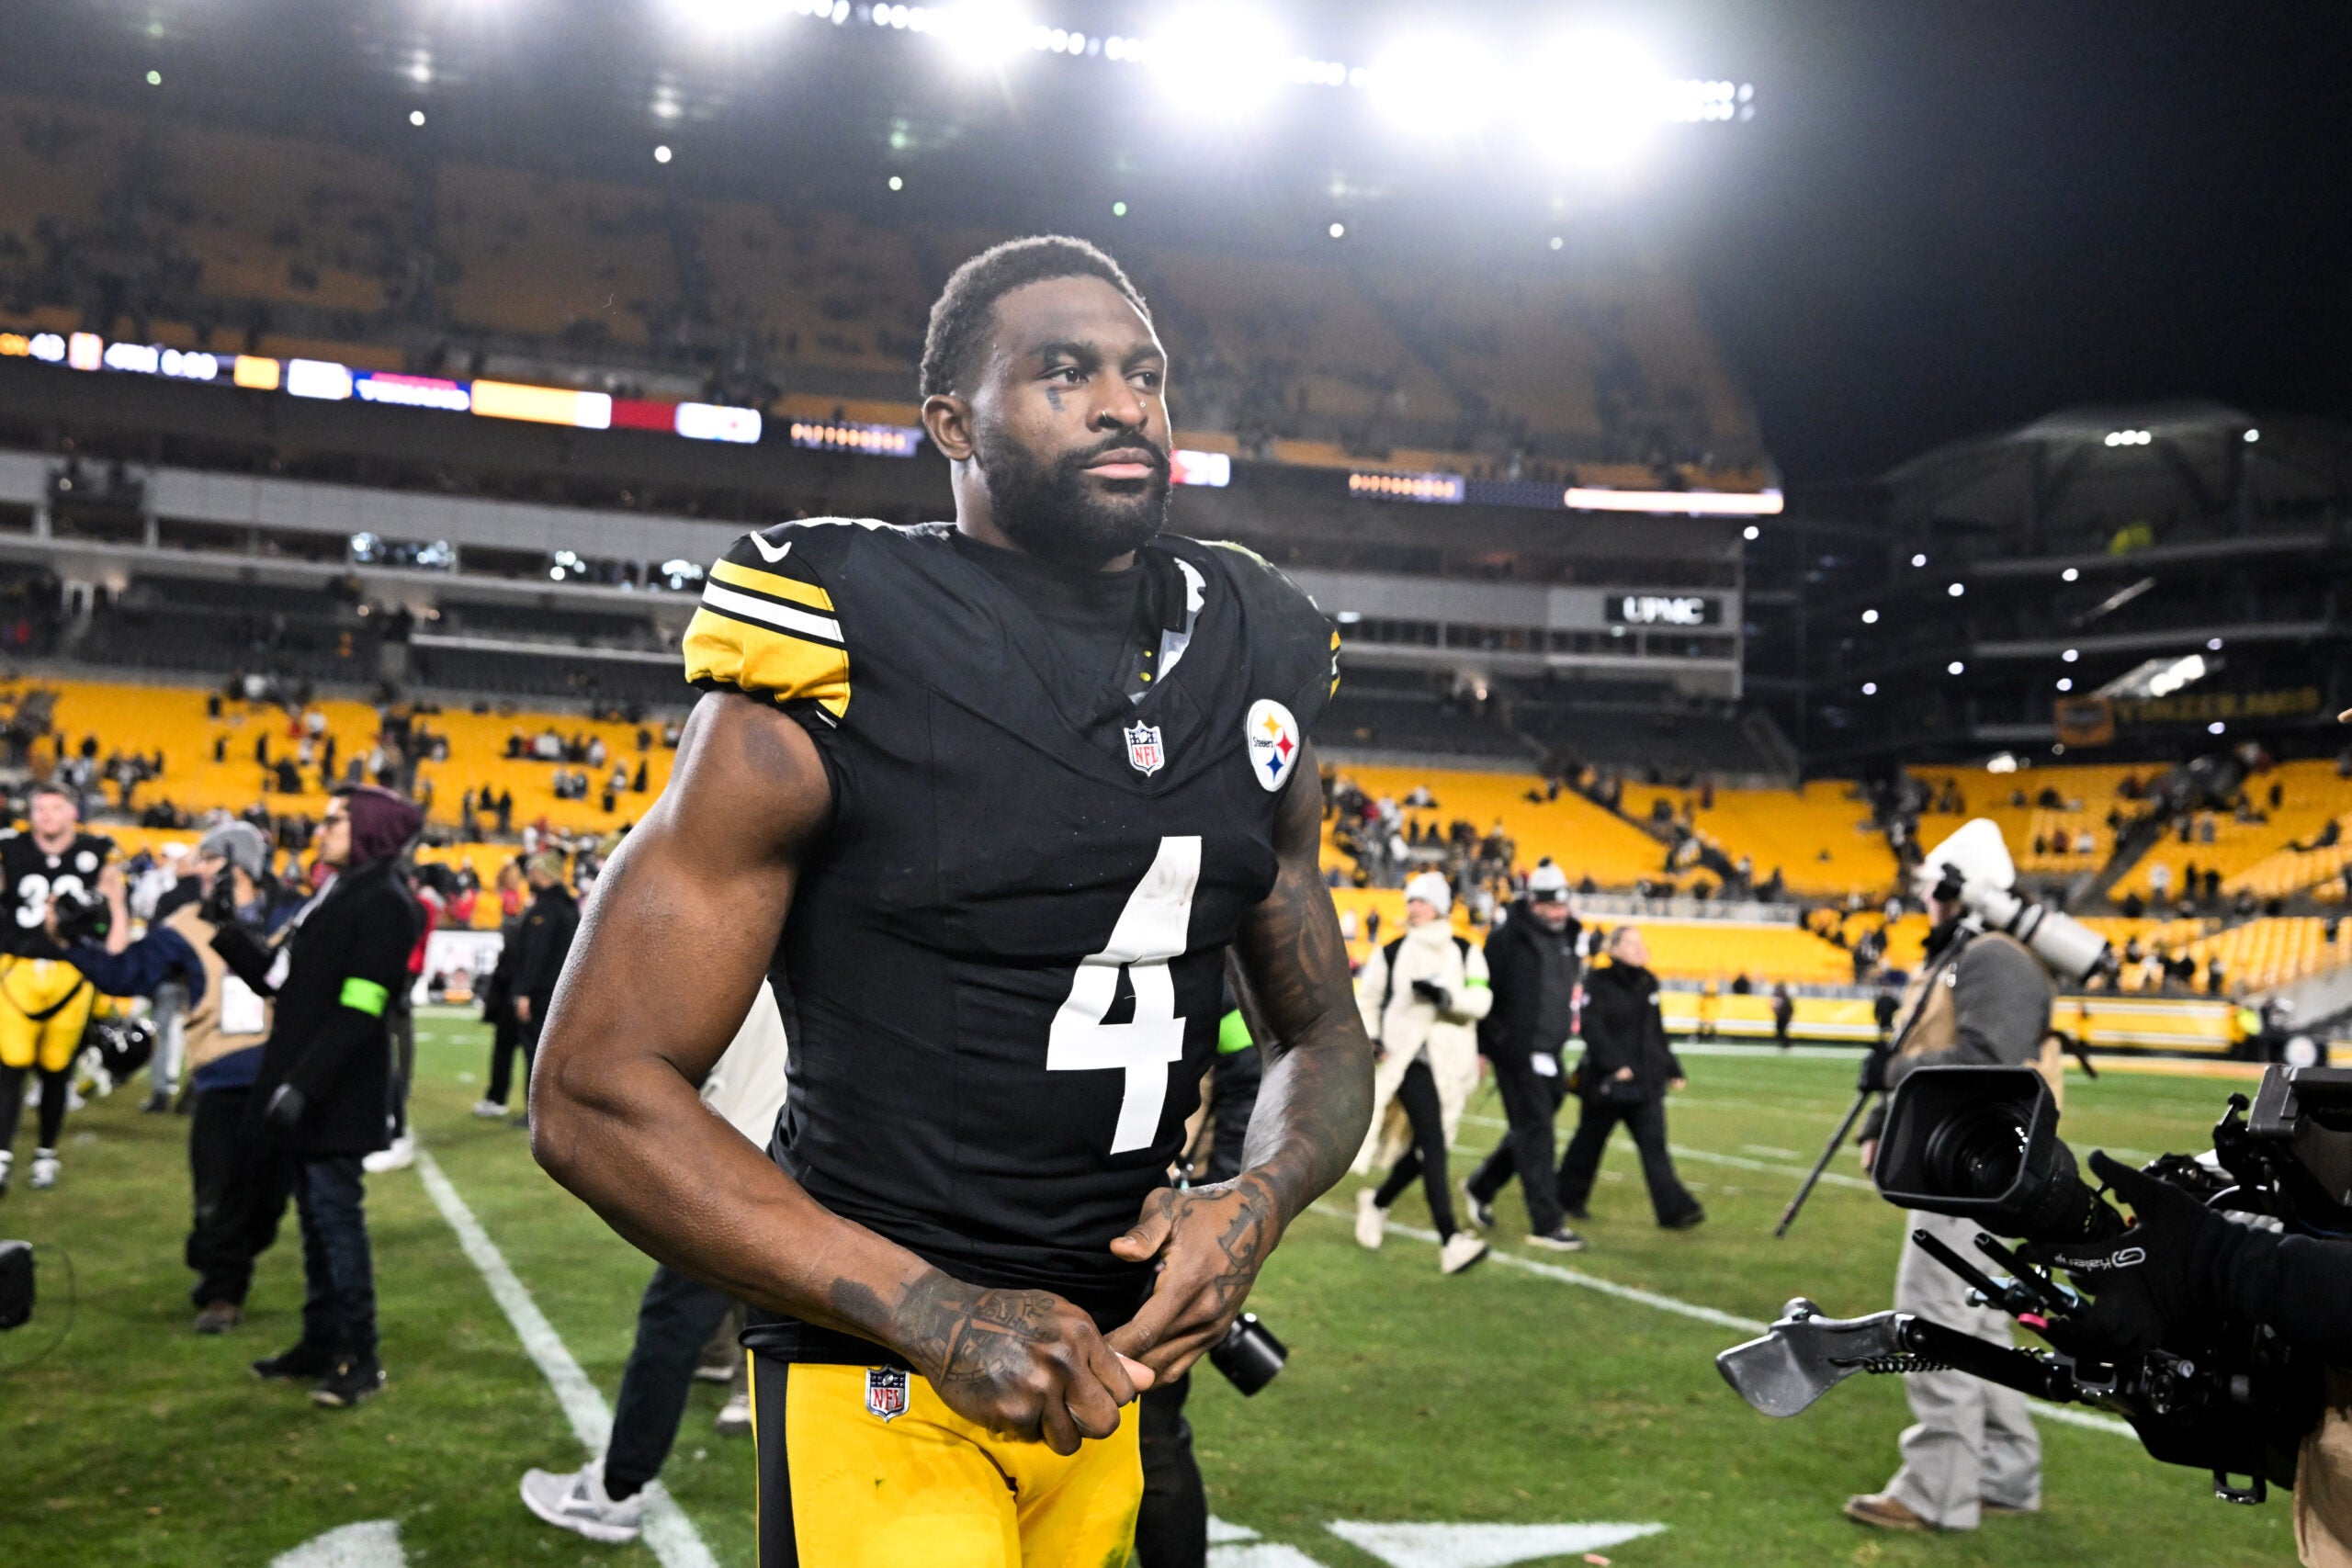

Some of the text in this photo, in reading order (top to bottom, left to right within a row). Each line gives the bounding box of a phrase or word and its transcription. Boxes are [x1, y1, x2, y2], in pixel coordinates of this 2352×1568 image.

[1135, 746, 1159, 766] NFL
[1046, 836, 1202, 1155] 4
[873, 1388, 903, 1411] NFL
